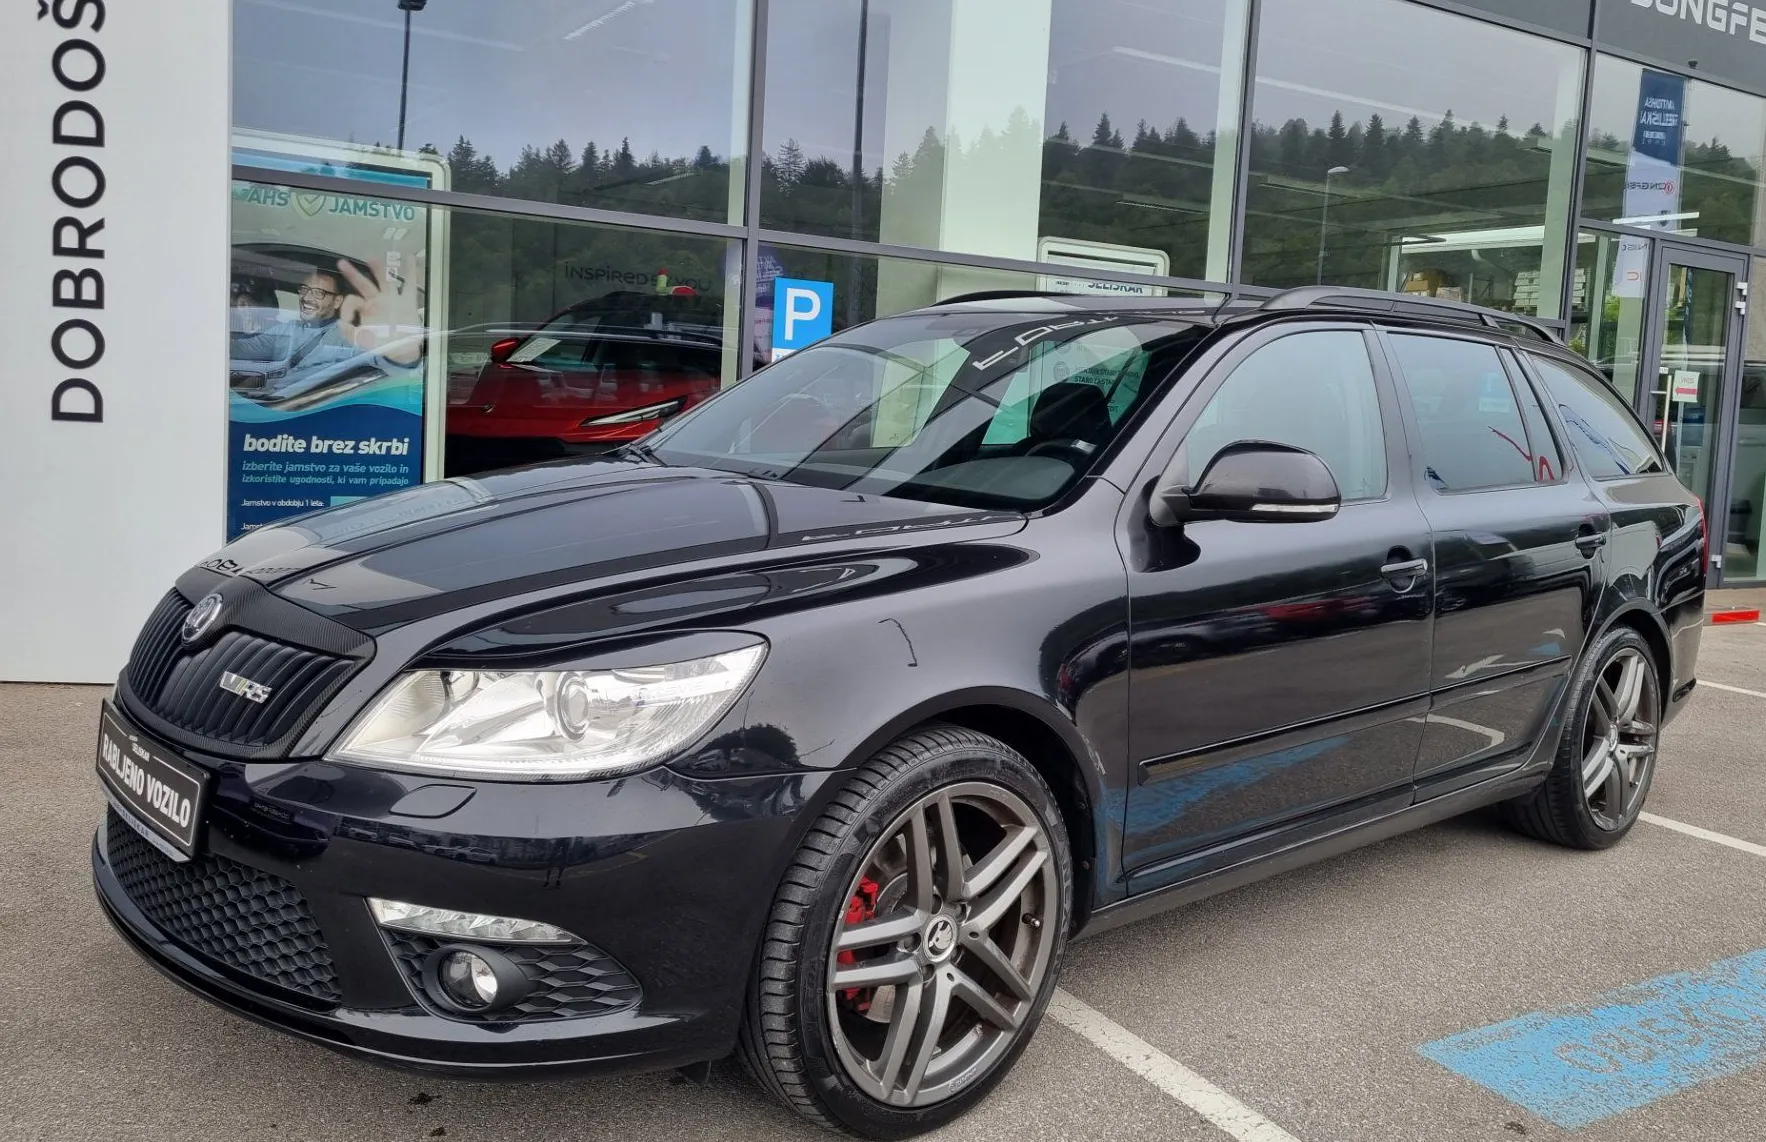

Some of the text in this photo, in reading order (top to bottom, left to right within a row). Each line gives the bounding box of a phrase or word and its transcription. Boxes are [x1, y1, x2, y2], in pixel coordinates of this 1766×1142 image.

[329, 198, 415, 221] JAMSTVO
[784, 287, 821, 341] P
[243, 434, 410, 455] bodite brez skrbi
[242, 461, 409, 473] izberite jamstvo za vaše vozilo in
[242, 474, 287, 483] izkoristite
[289, 476, 335, 485] ugodnosti,
[337, 476, 346, 484] ki
[369, 477, 409, 486] pripadajo
[241, 499, 271, 507] Jamstvo
[102, 733, 191, 828] RABLJENO VOZILO
